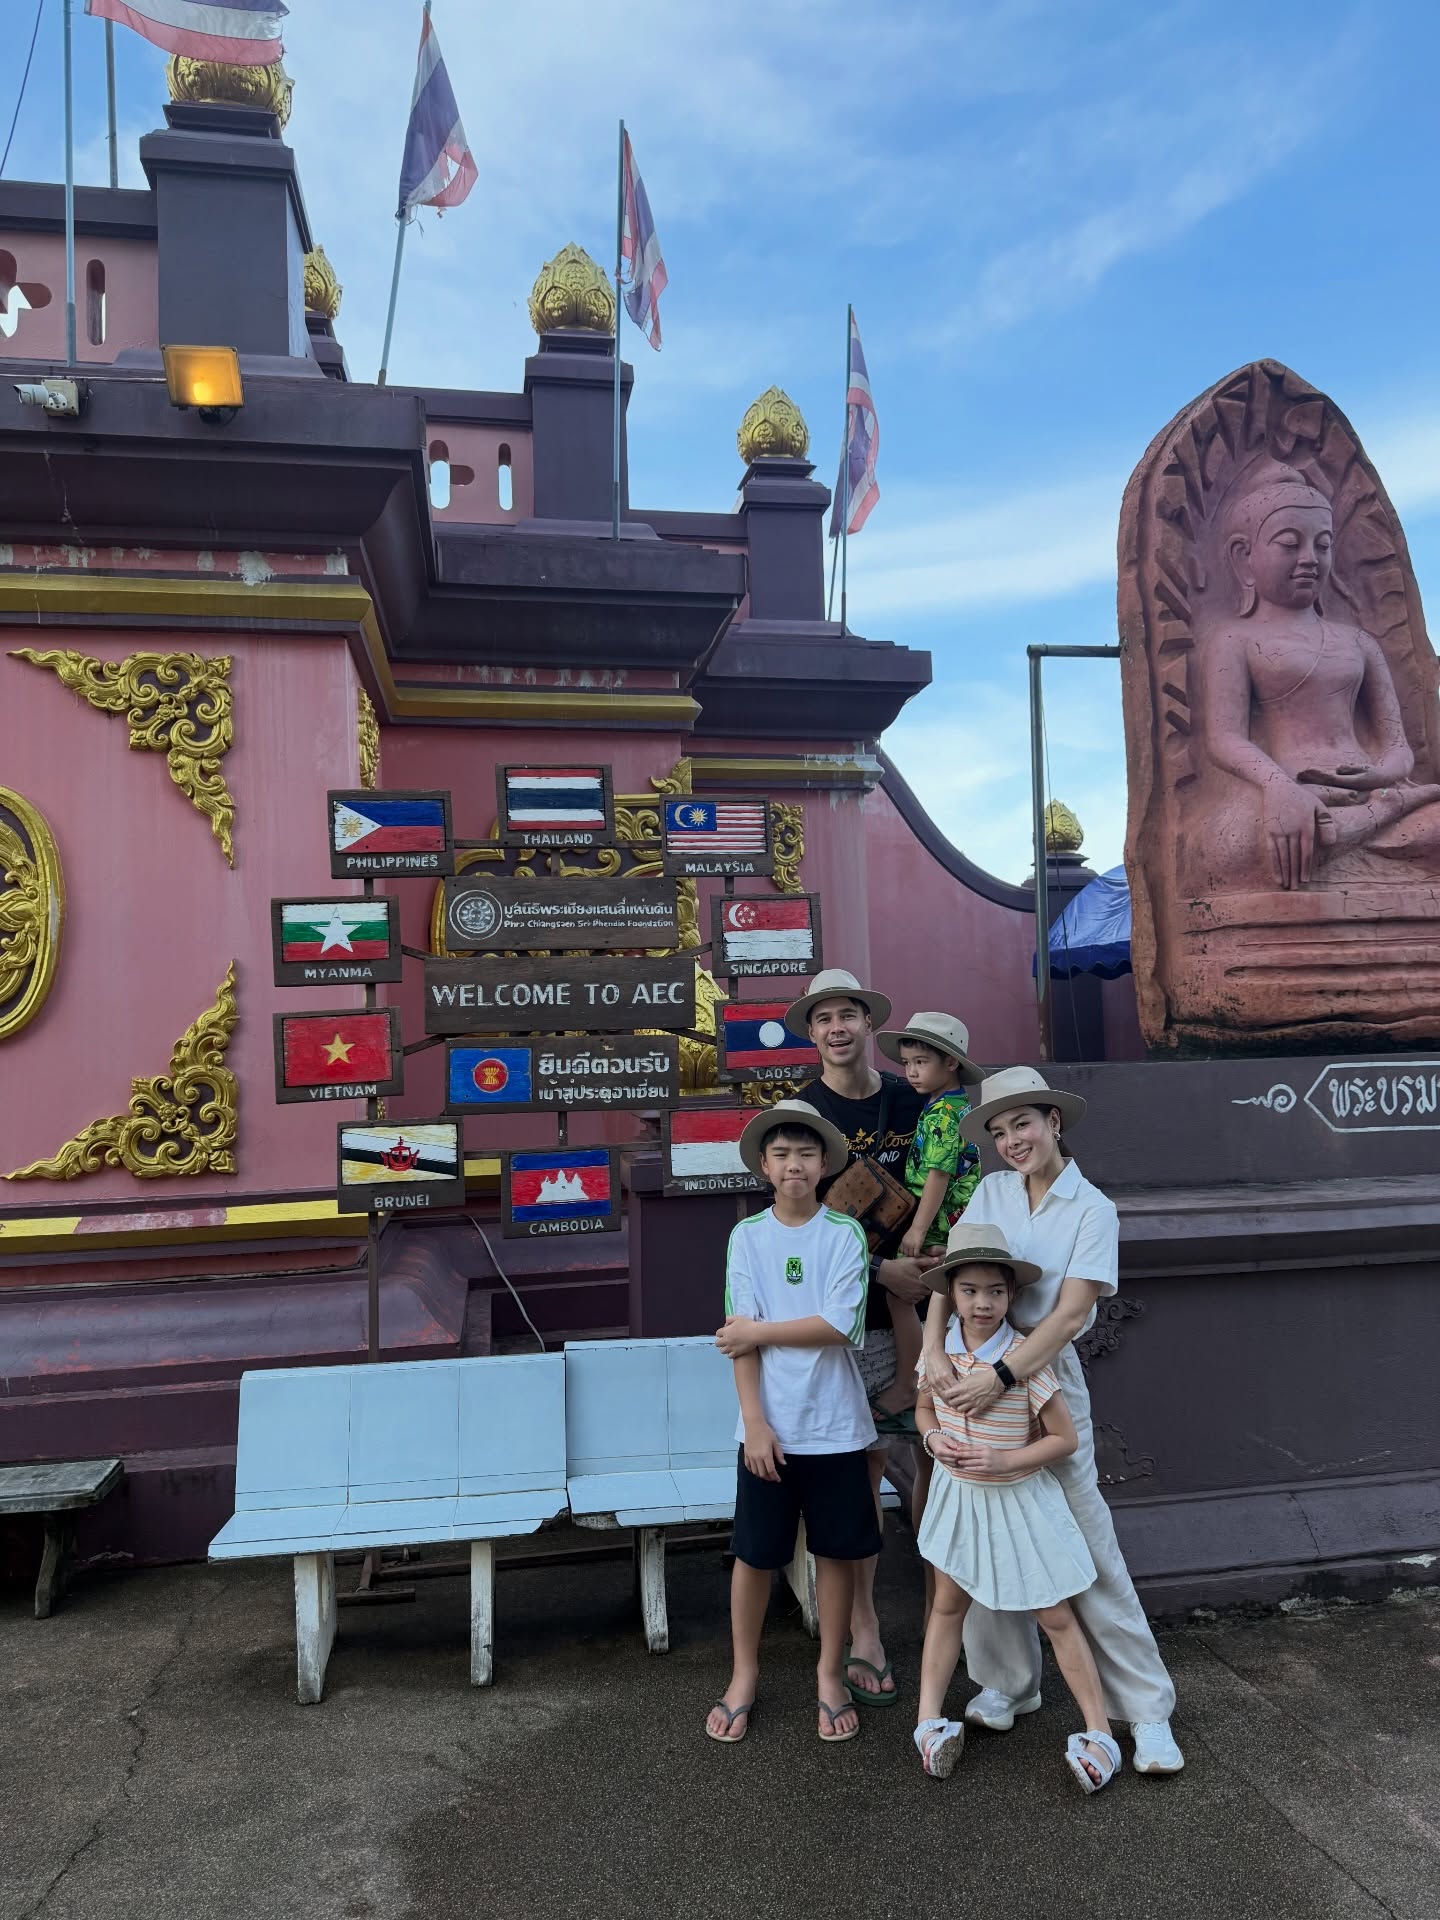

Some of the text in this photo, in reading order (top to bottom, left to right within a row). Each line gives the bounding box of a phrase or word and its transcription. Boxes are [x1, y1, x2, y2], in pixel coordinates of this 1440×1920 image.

[522, 833, 593, 845] THAILAND
[346, 854, 439, 869] PHILIPPINES
[685, 861, 755, 873] MALAYSIA
[503, 919, 525, 928] Phra
[527, 919, 576, 930] Chiangsaen
[577, 919, 591, 928] Sri
[627, 918, 674, 928] Foundation
[304, 967, 373, 979] MYANMA
[730, 962, 808, 975] SINGAPORE
[431, 982, 685, 1007] WELCOME TO AEC
[756, 1067, 792, 1080] LAOS
[309, 1084, 377, 1099] VIETNAM
[1328, 1073, 1440, 1118] พระบรม
[684, 1176, 758, 1191] INDONESIA
[374, 1194, 430, 1208] BRUNEI
[529, 1218, 605, 1235] CAMBODIA
